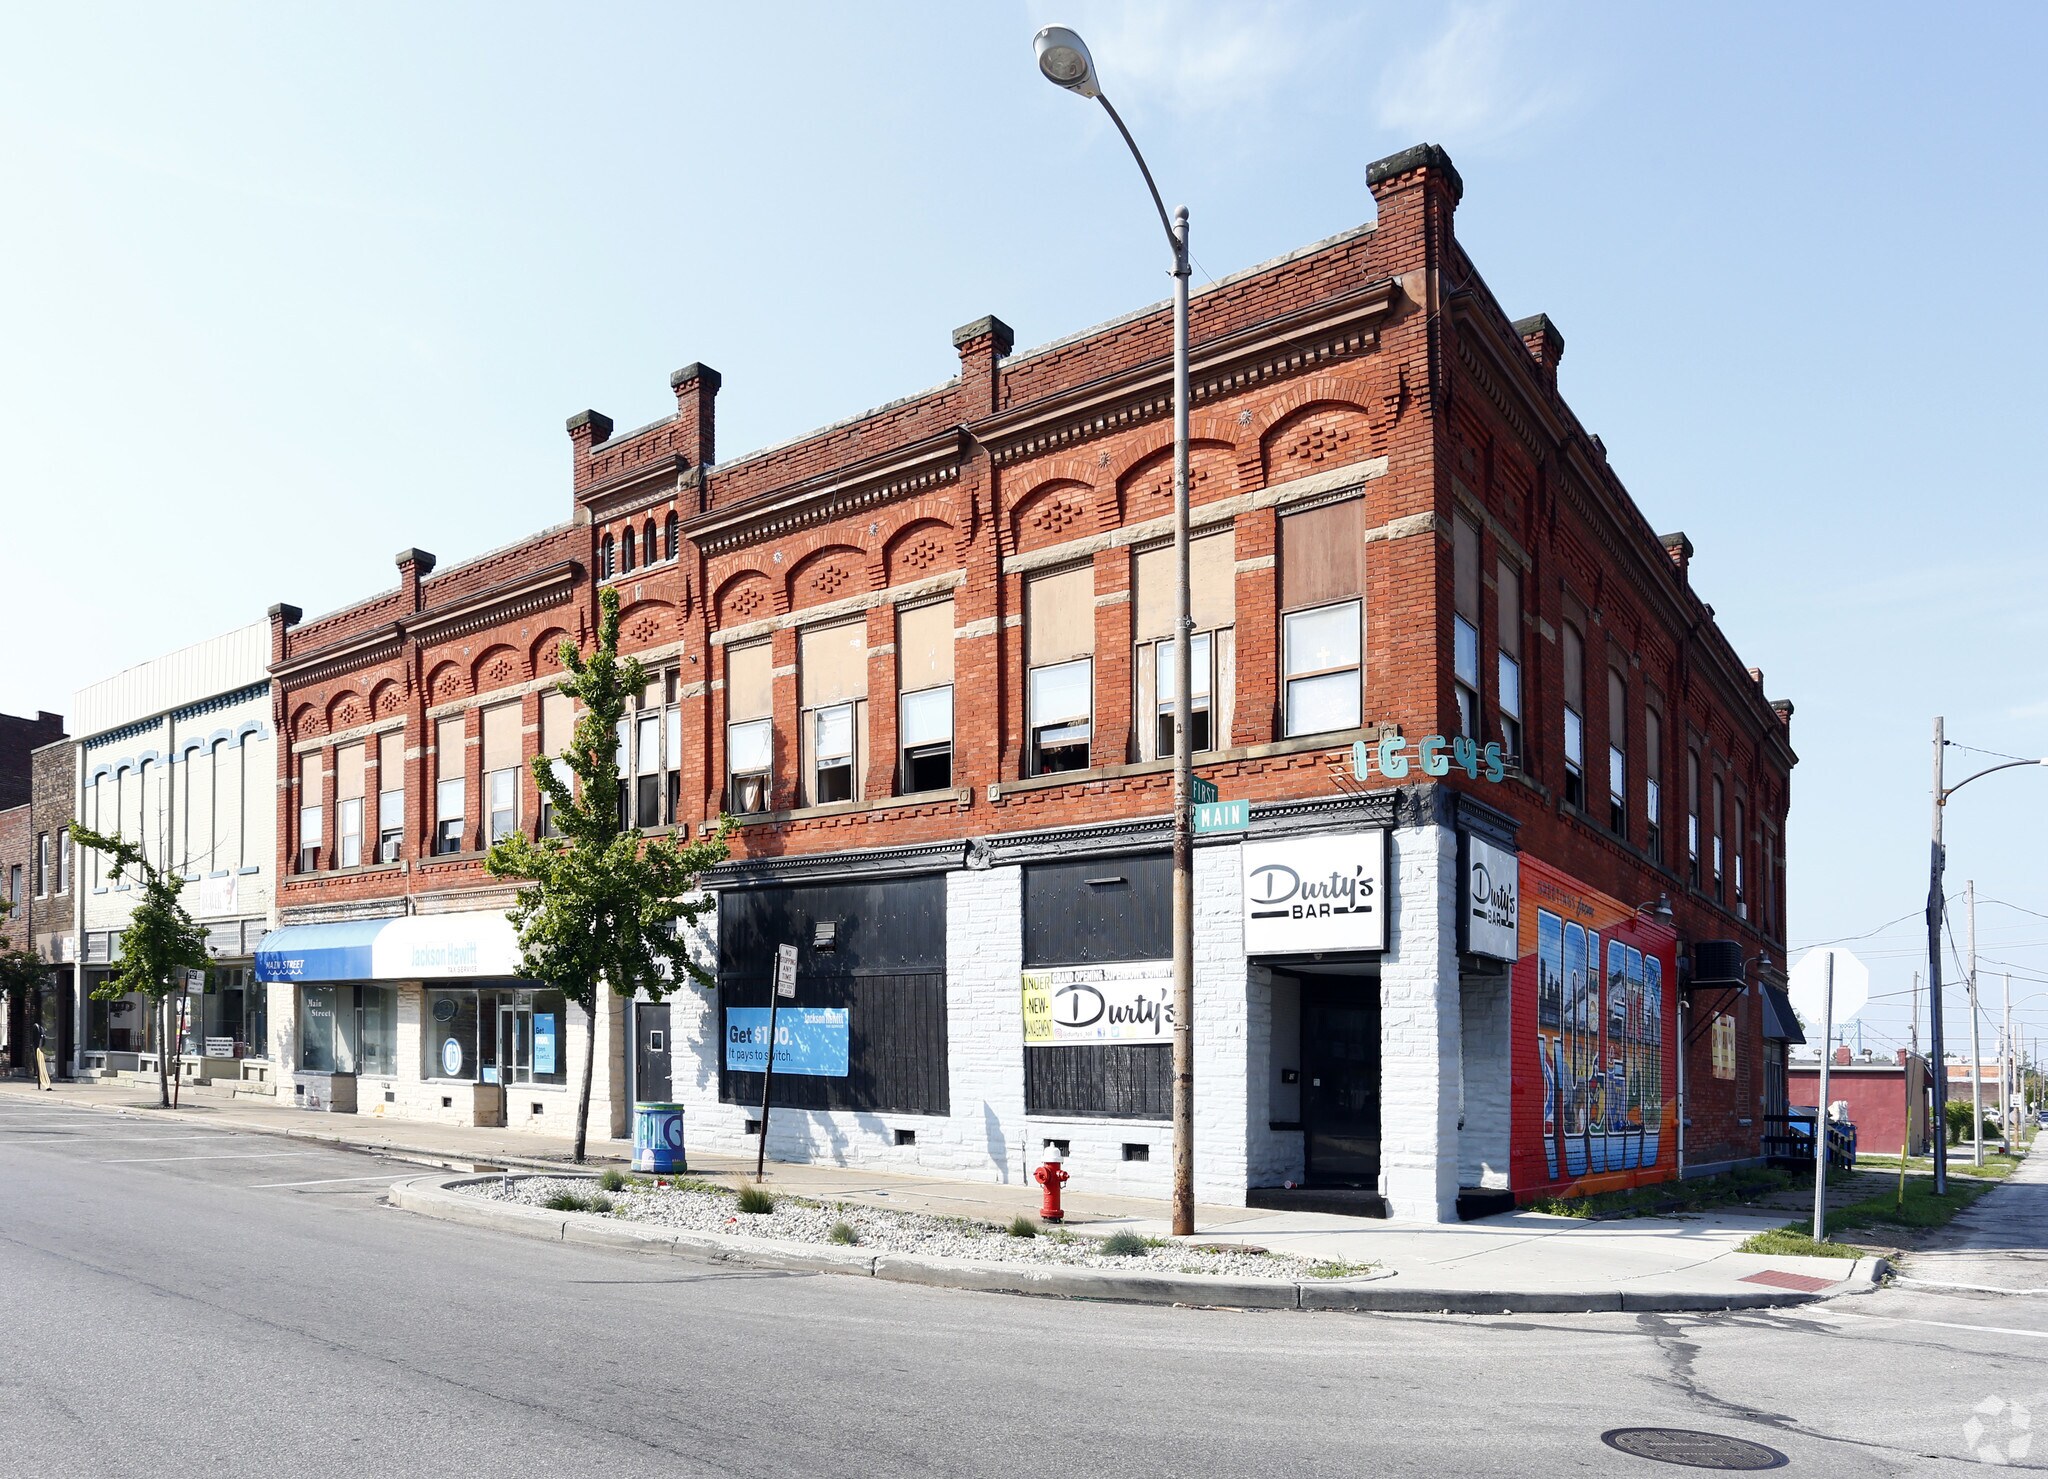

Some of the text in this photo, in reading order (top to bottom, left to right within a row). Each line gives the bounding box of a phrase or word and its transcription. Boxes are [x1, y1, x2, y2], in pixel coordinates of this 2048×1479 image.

[1193, 780, 1215, 803] FIRST
[1202, 805, 1239, 828] MAIN
[1249, 864, 1374, 909] Durty's
[1472, 862, 1516, 922] Durty's
[1292, 903, 1331, 920] BAR
[1488, 909, 1502, 928] BAR
[411, 941, 478, 967] Jackson Hewitt
[265, 960, 305, 970] MAIN STREET
[783, 965, 792, 973] ANY
[1022, 976, 1050, 990] UNDER
[307, 999, 322, 1007] Main
[1053, 984, 1174, 1035] Durty's
[311, 1009, 331, 1017] Street
[804, 1013, 825, 1024] Jackson
[1537, 907, 1662, 1142] TOLEDO
[730, 1025, 752, 1044] Get
[729, 1047, 735, 1059] It
[736, 1050, 754, 1063] pays
[755, 1049, 763, 1060] to
